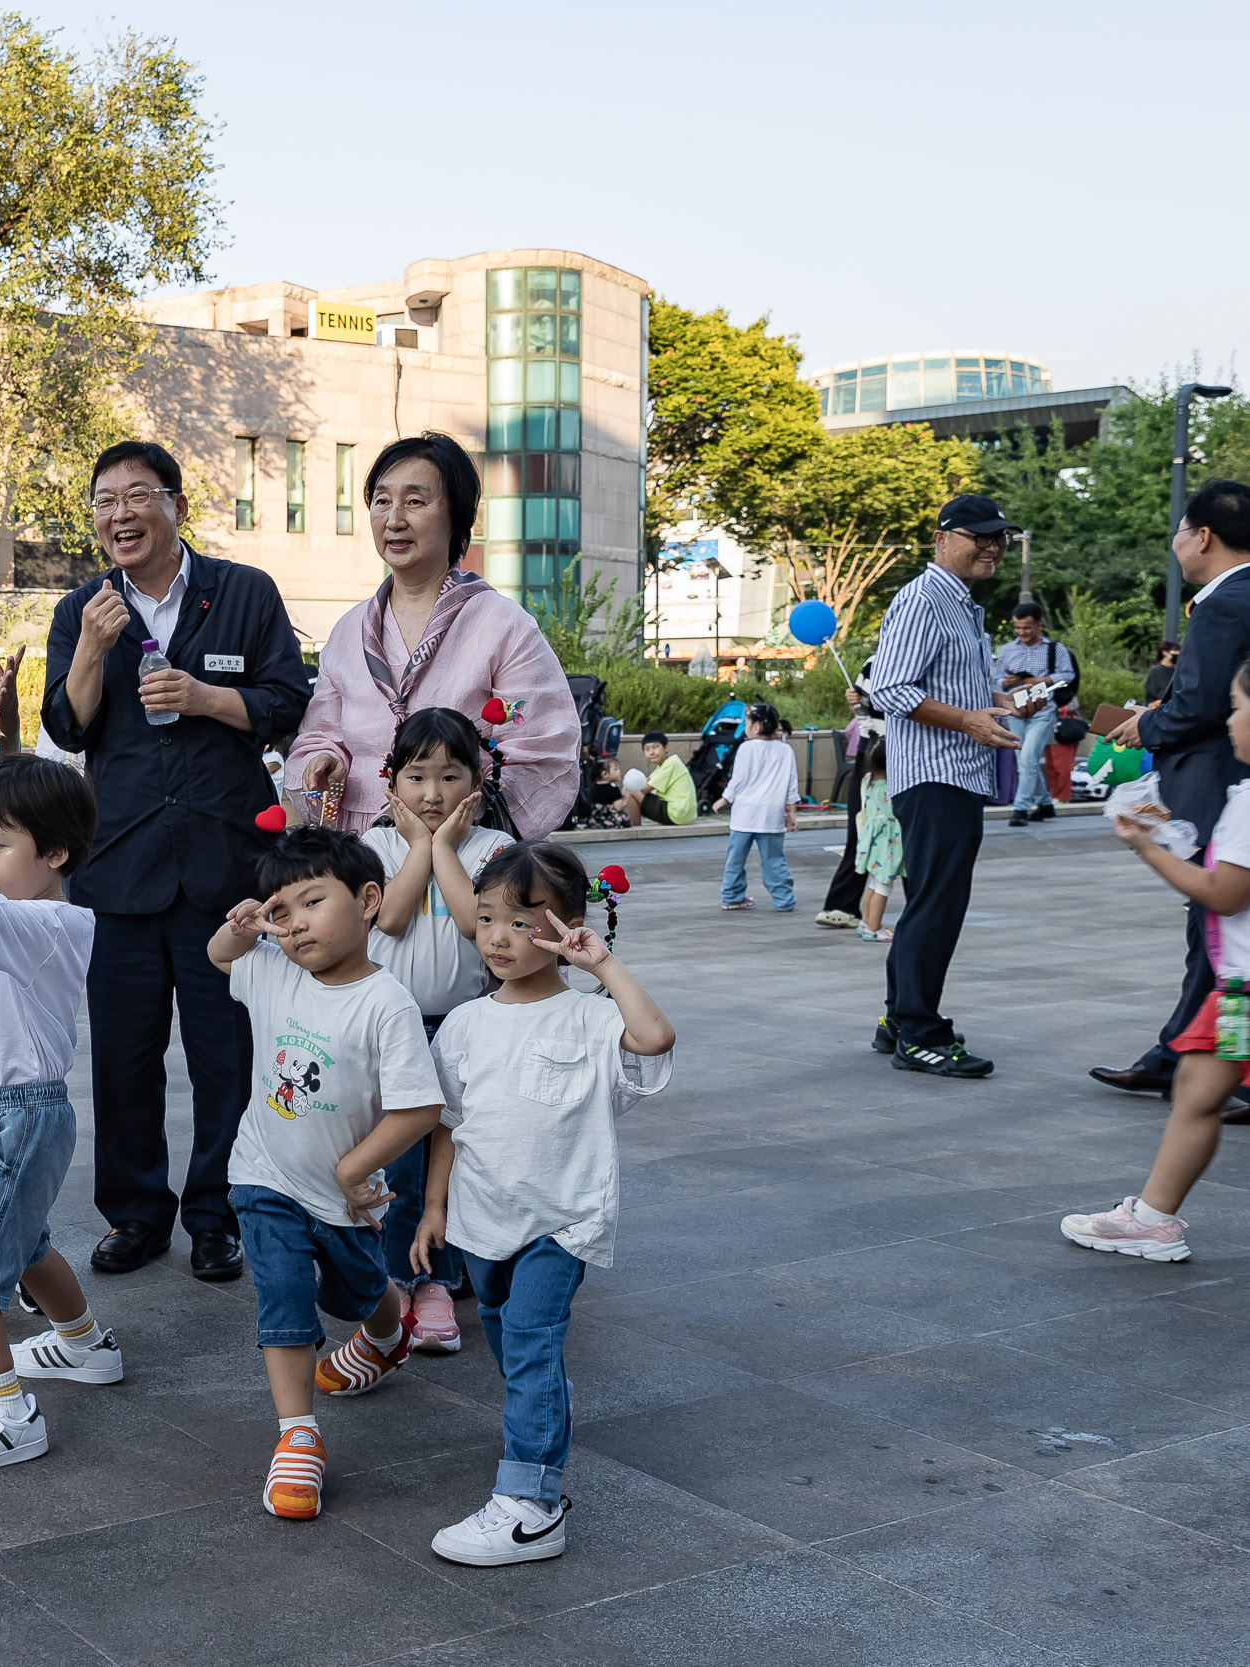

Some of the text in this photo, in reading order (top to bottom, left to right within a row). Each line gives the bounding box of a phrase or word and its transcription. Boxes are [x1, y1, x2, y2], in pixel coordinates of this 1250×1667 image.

[318, 311, 374, 332] TENNIS
[286, 1016, 332, 1044] Worry about
[281, 1035, 326, 1063] NOTHING
[261, 1074, 339, 1113] ALL DAY
